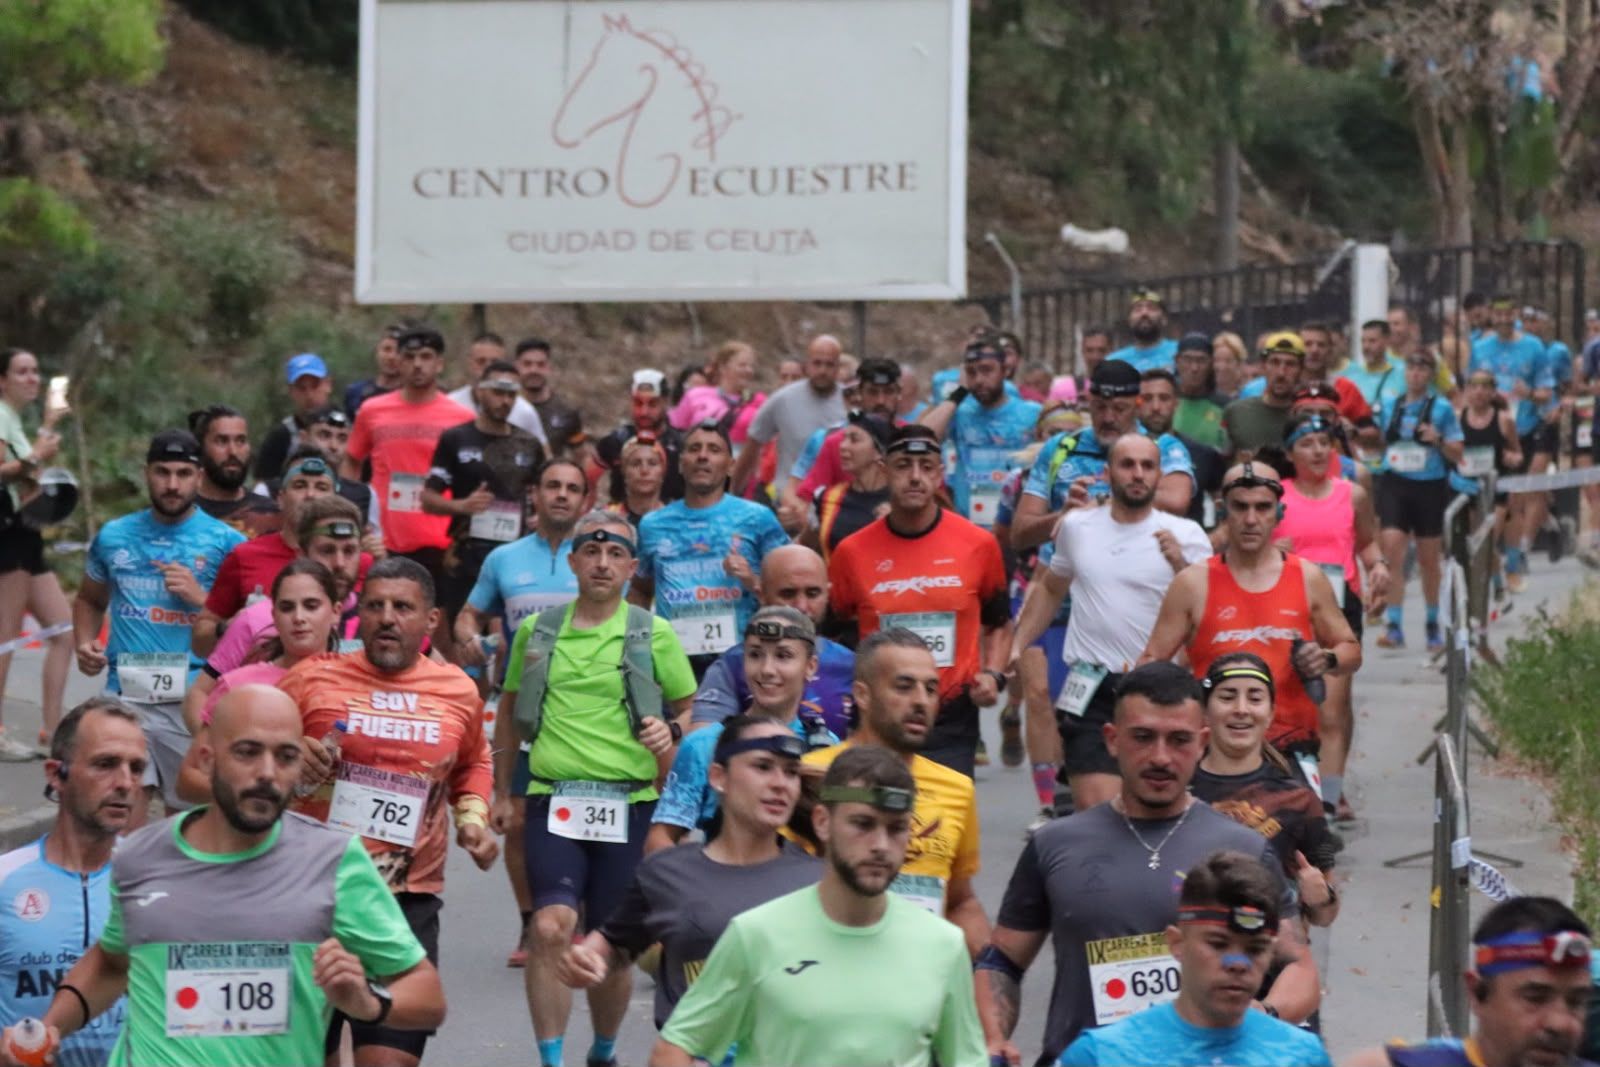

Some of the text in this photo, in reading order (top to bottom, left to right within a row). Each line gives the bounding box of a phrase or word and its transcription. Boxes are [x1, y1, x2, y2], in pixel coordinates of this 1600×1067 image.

[413, 161, 919, 199] CENTRO ECUESTRE
[506, 228, 819, 254] CIUDAD DE CEUTA
[704, 623, 722, 640] 21
[152, 674, 173, 690] 79
[370, 689, 419, 714] SOY
[347, 712, 441, 744] FUERTE
[371, 798, 411, 826] 762
[584, 806, 616, 826] 341
[20, 950, 77, 965] club de
[168, 943, 290, 970] IX CARRERA NOCTURNA
[1087, 941, 1106, 965] IX
[1105, 935, 1149, 951] CARRERA
[1131, 967, 1180, 997] 630
[220, 982, 274, 1010] 108
